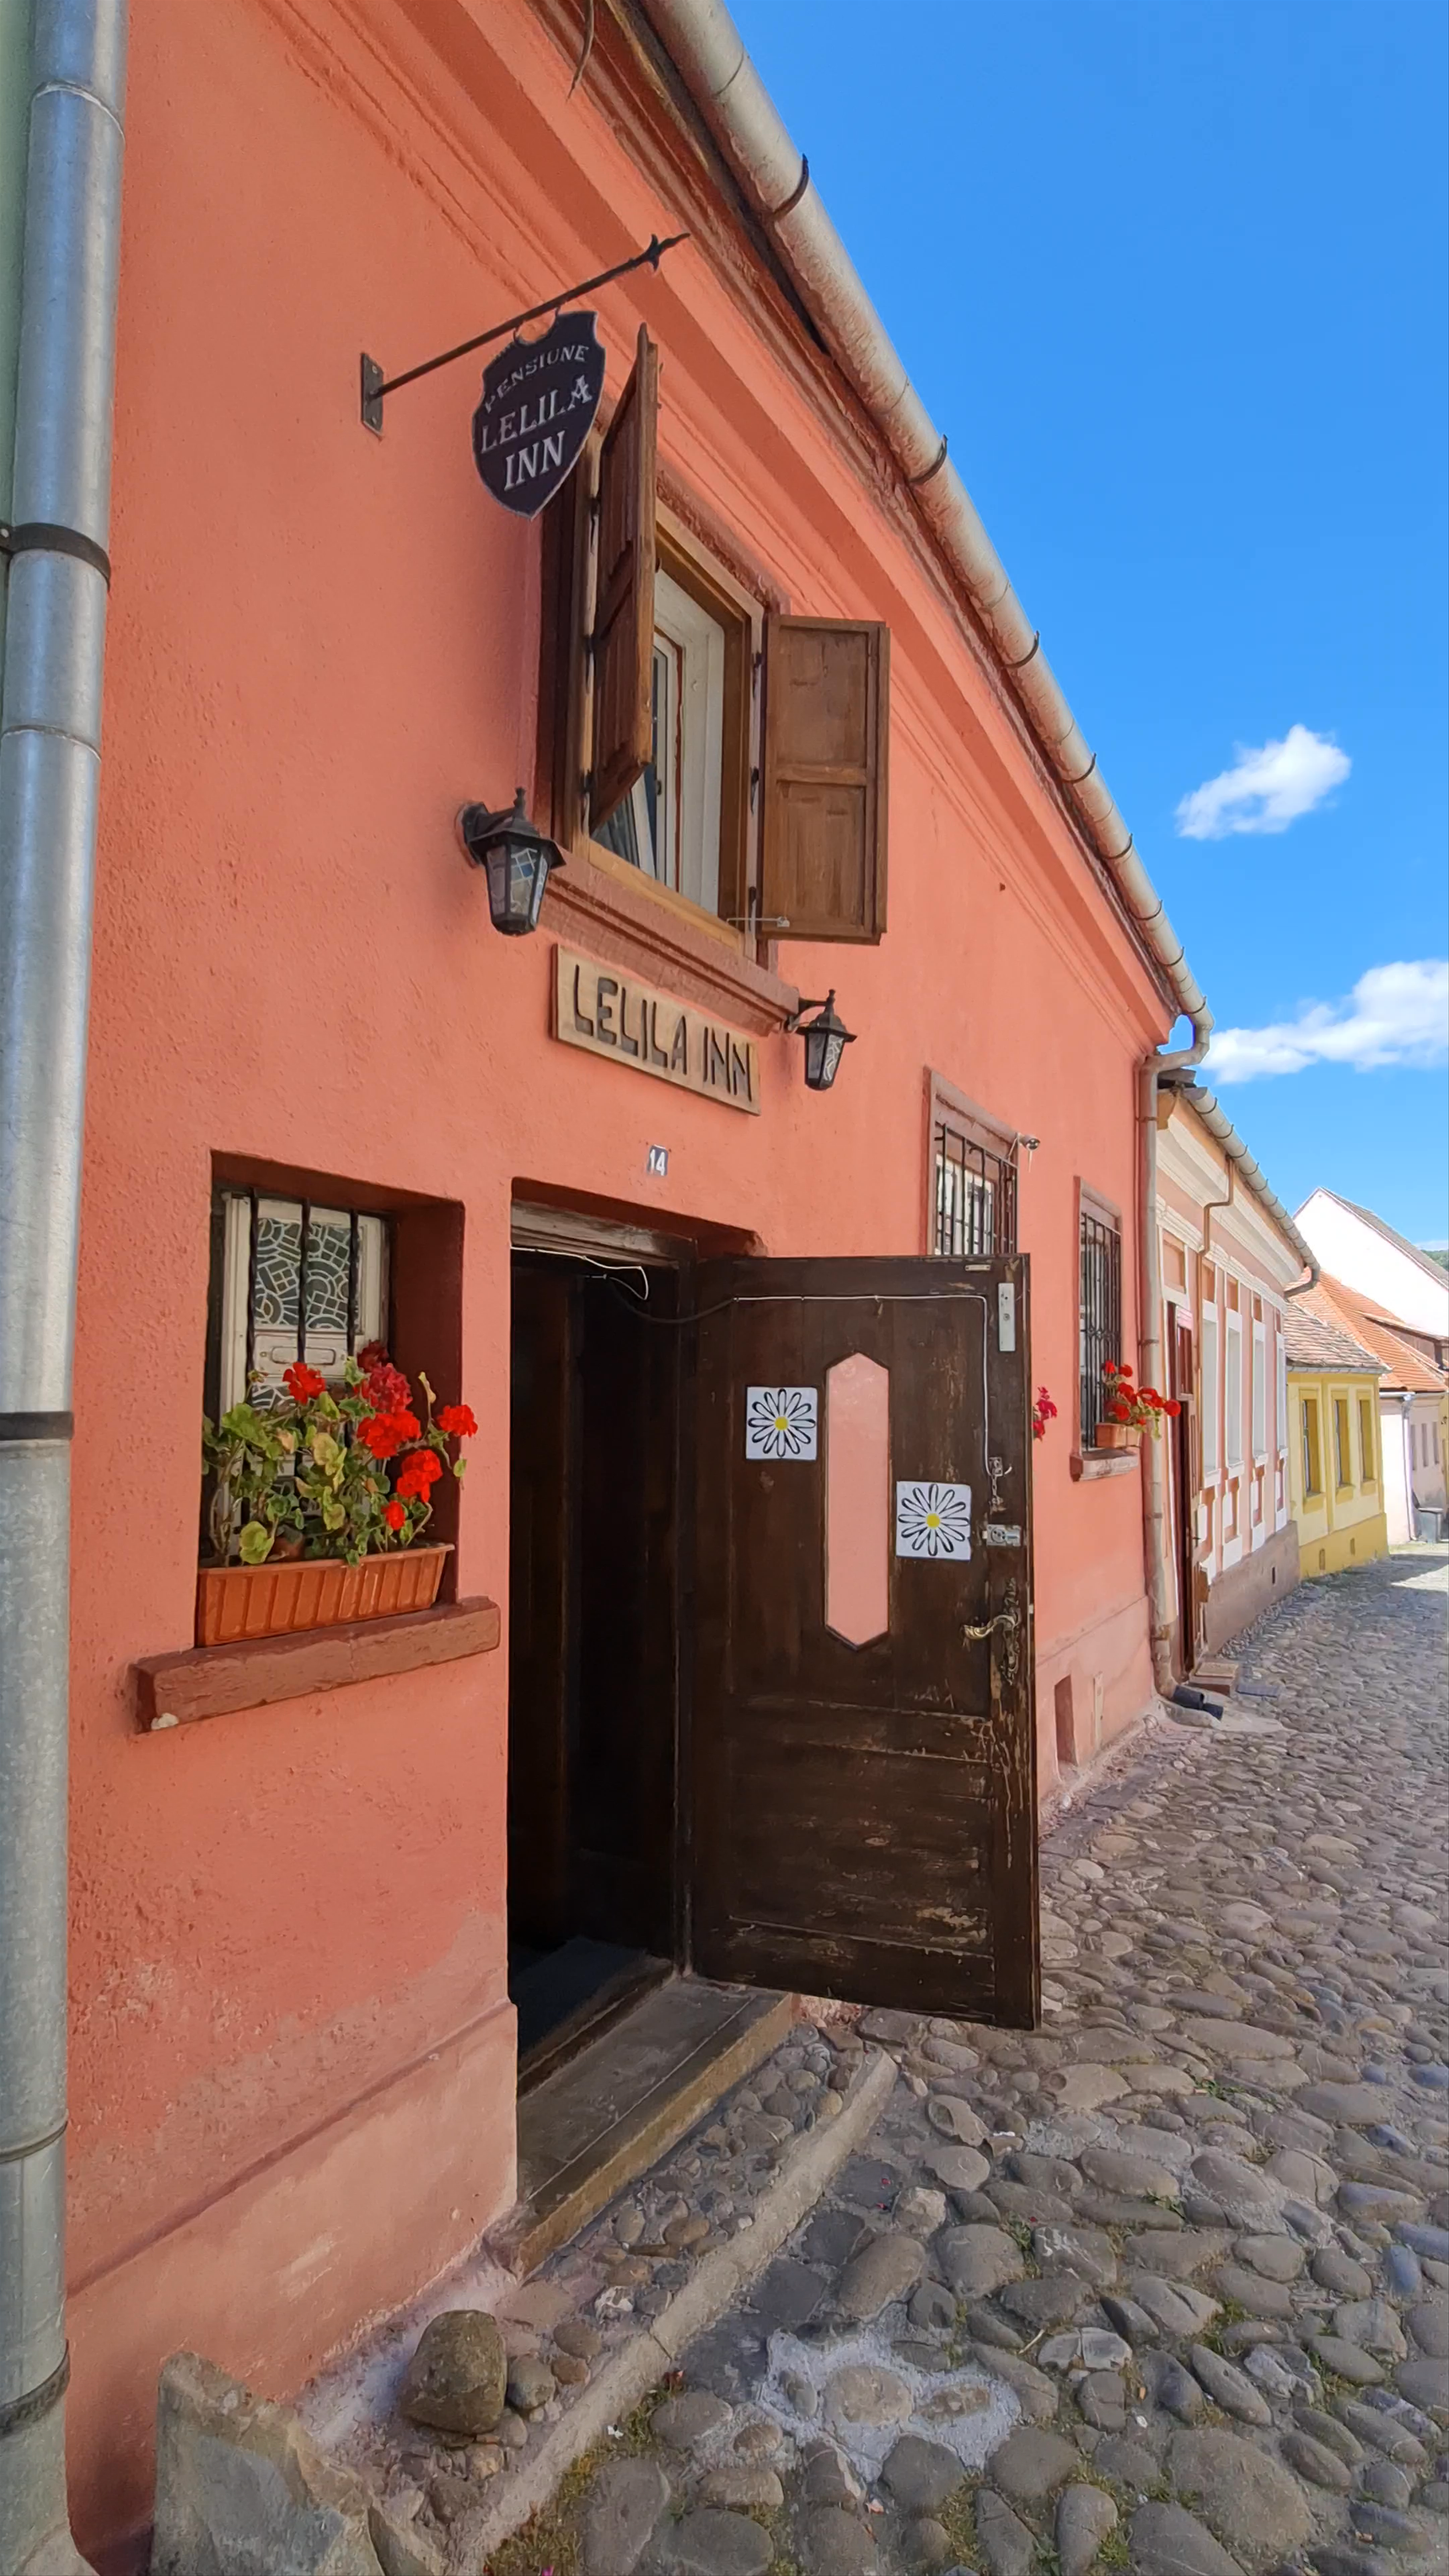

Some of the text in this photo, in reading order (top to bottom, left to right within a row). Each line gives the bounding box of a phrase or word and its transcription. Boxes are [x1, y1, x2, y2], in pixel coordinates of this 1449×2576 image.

[485, 345, 589, 413] PENSIUNE
[481, 375, 592, 454] LELILA
[504, 431, 565, 491] INN
[574, 964, 752, 1102] LELILA INN
[649, 1149, 665, 1176] 14
